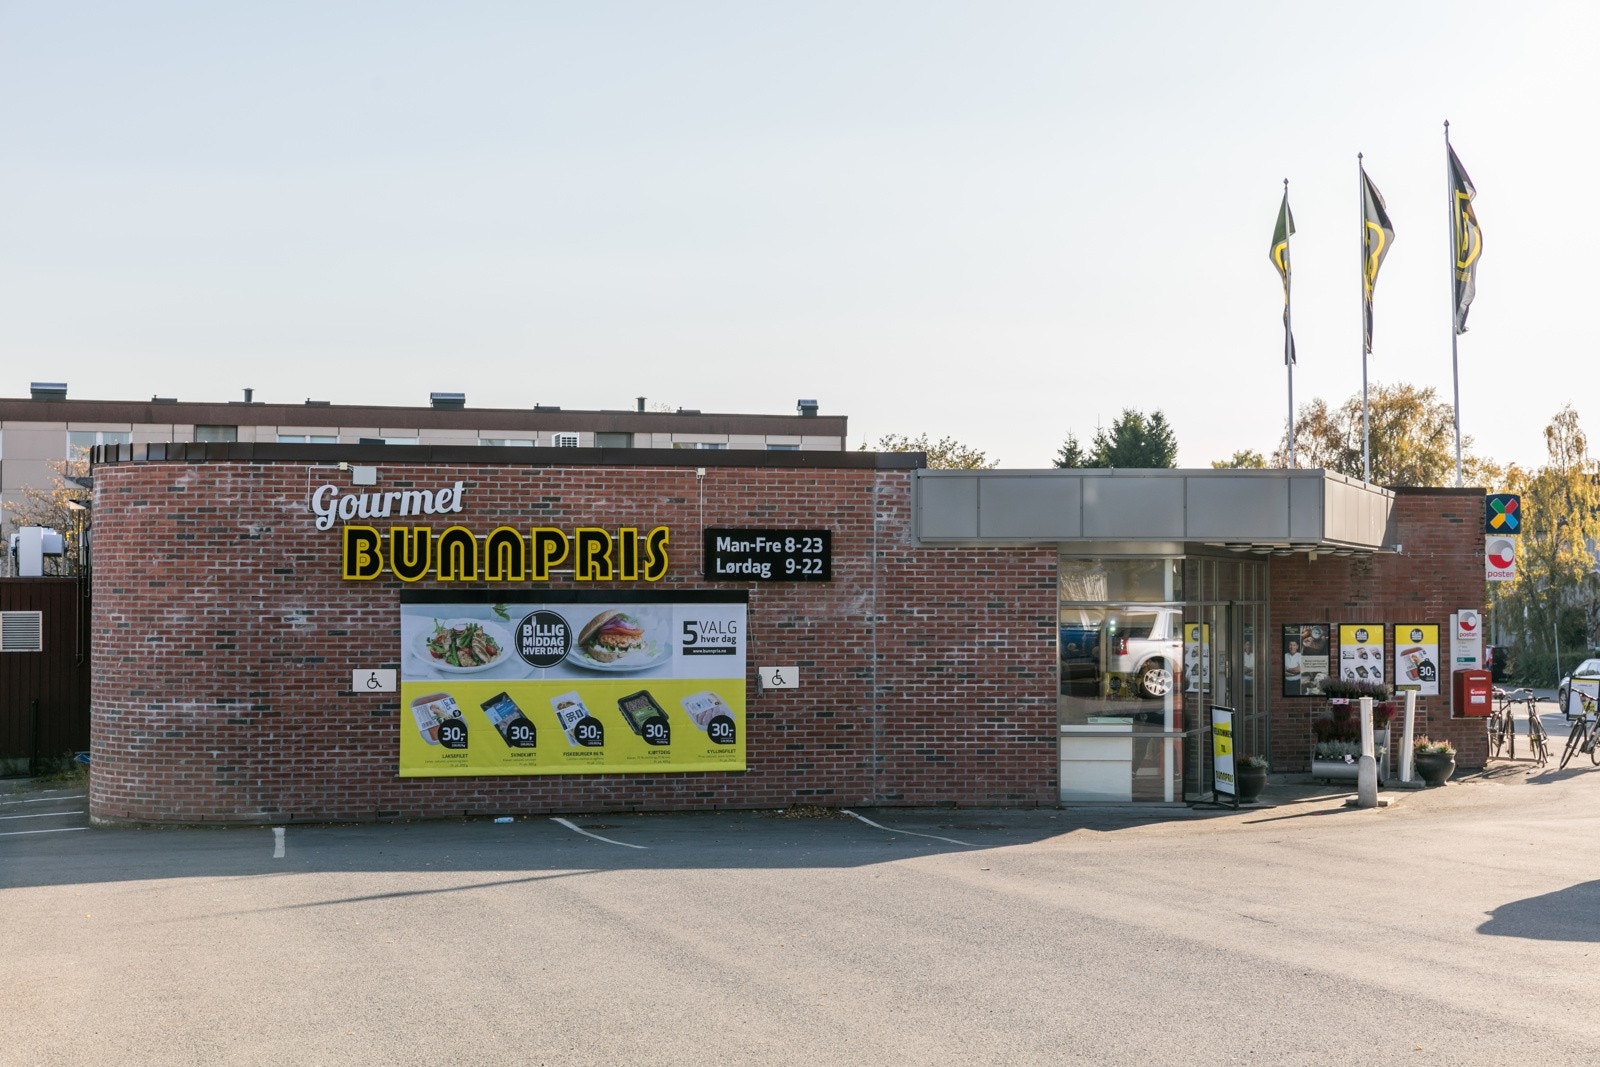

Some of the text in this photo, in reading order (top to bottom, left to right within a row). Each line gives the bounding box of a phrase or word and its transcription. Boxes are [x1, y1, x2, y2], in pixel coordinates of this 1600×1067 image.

[311, 481, 467, 531] Gourmet
[716, 536, 823, 553] Man-Fre 8-23
[342, 525, 669, 582] BUNNPRIS
[716, 557, 823, 578] Lørdag 9-22
[1487, 570, 1514, 579] posten
[523, 622, 564, 636] BILLIG
[683, 620, 737, 645] 5 VALG
[523, 636, 564, 647] MIDDAG
[700, 634, 737, 645] hver dag
[523, 647, 564, 655] HVER DAG
[1419, 666, 1435, 677] 30,-
[442, 726, 466, 742] 30,-
[511, 726, 534, 741] 30,-
[578, 725, 602, 740] 30,-
[645, 724, 669, 739] 30,-
[711, 723, 734, 738] 30,-
